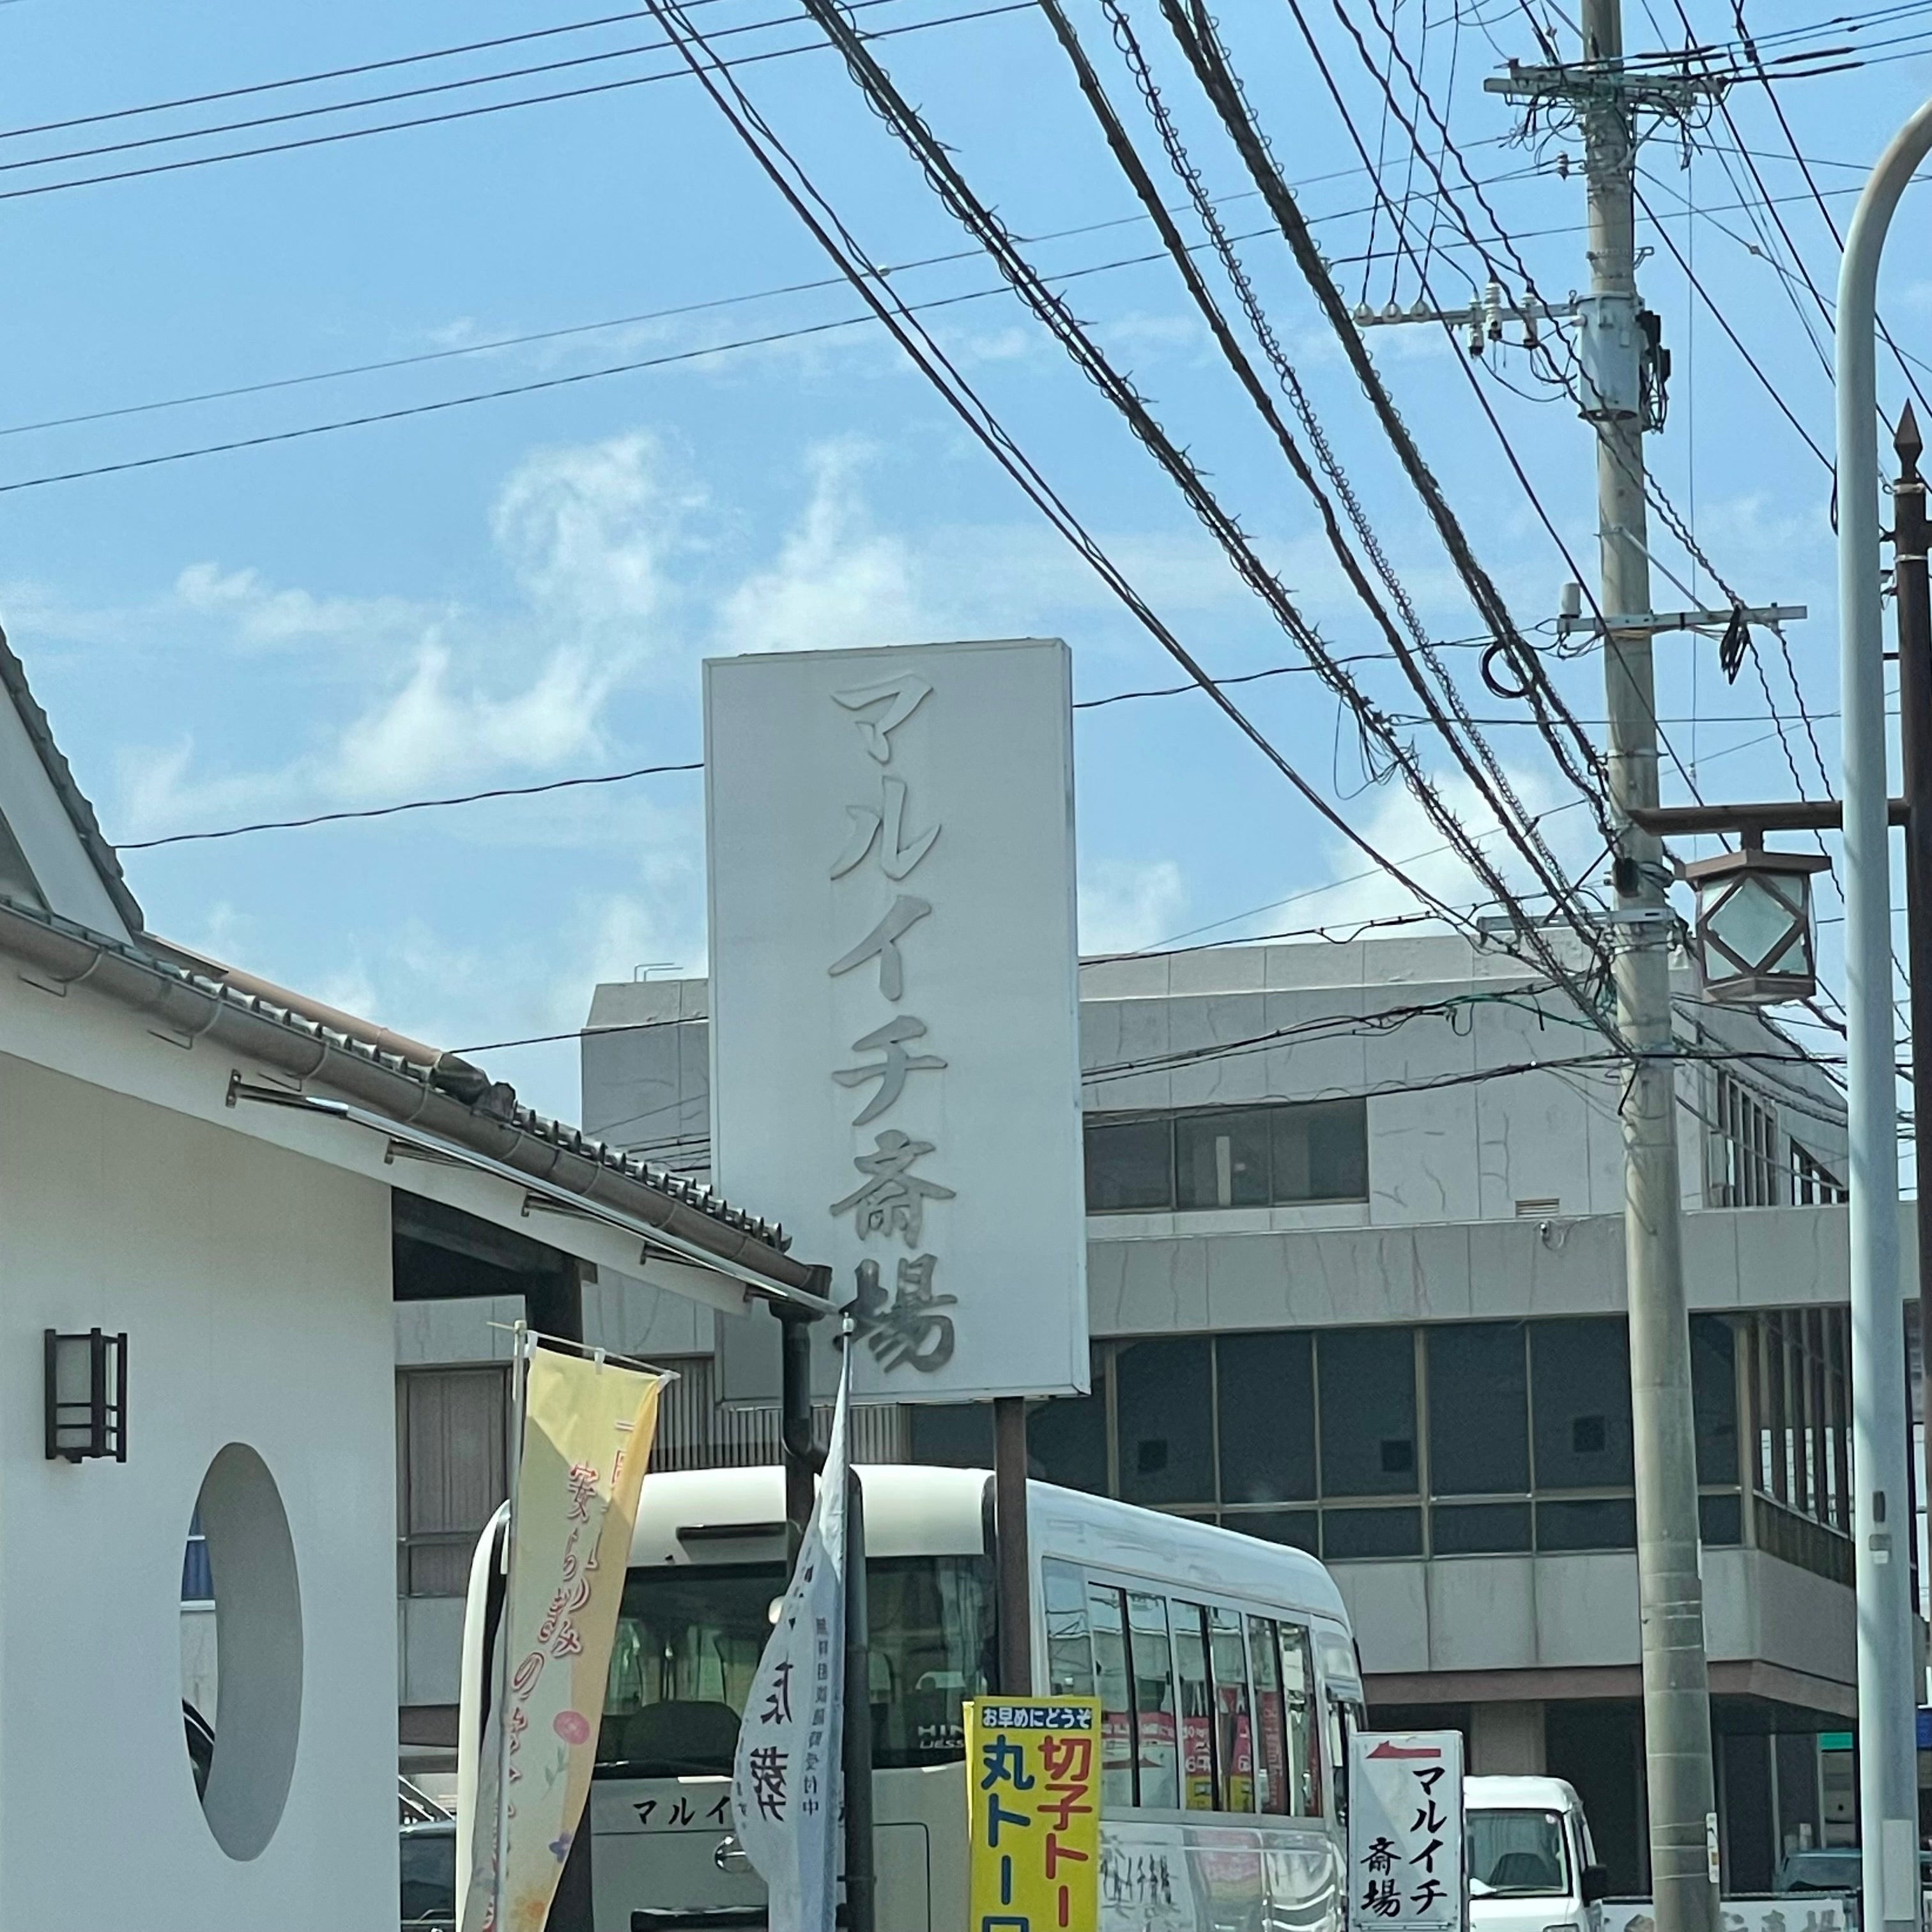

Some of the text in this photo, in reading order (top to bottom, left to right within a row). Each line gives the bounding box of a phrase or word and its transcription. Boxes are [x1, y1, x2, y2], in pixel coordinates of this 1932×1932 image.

[828, 673, 958, 1374] マルイチ斎場
[983, 1706, 1092, 1729] お早めにどうぞ
[1361, 1837, 1401, 1918] 斎場
[1409, 1767, 1448, 1915] マルイチ
